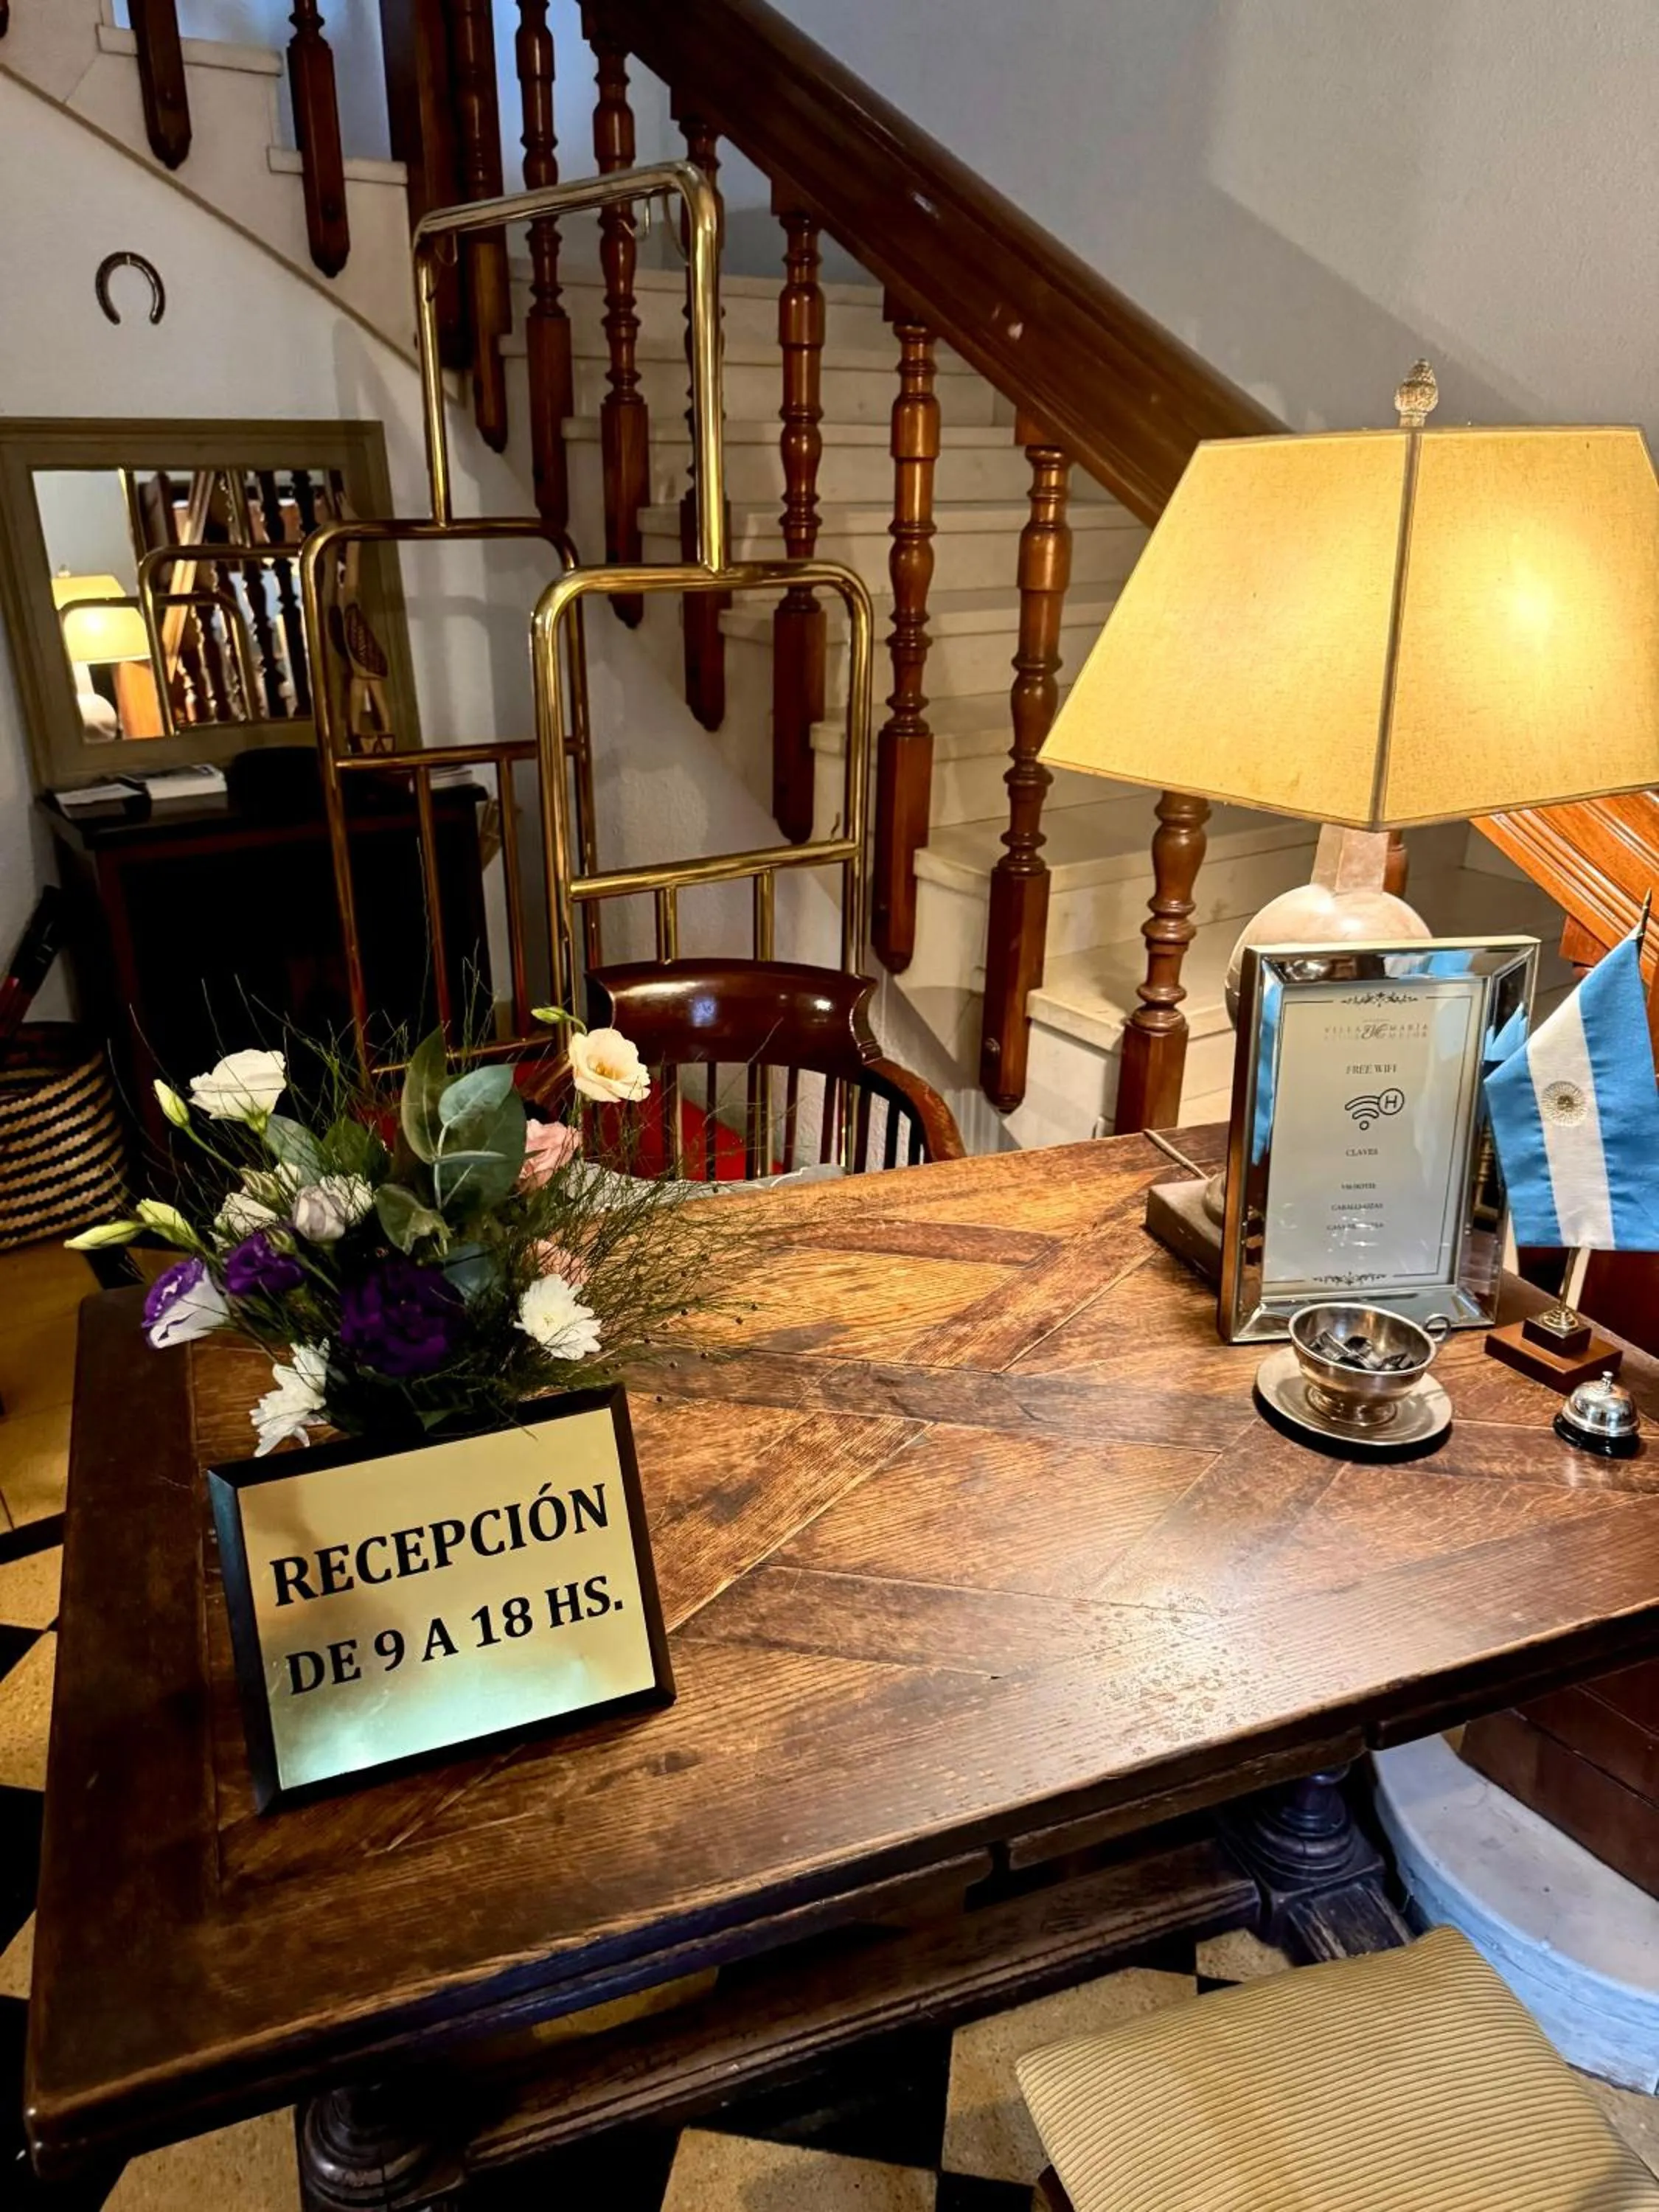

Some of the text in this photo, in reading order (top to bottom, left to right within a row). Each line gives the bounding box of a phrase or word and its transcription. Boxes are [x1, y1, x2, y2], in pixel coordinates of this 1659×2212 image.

[1346, 1065, 1373, 1074] FREE
[269, 1482, 608, 1607] RECEPCIÓN
[285, 1576, 624, 1696] DE 9 A 18 HS.
